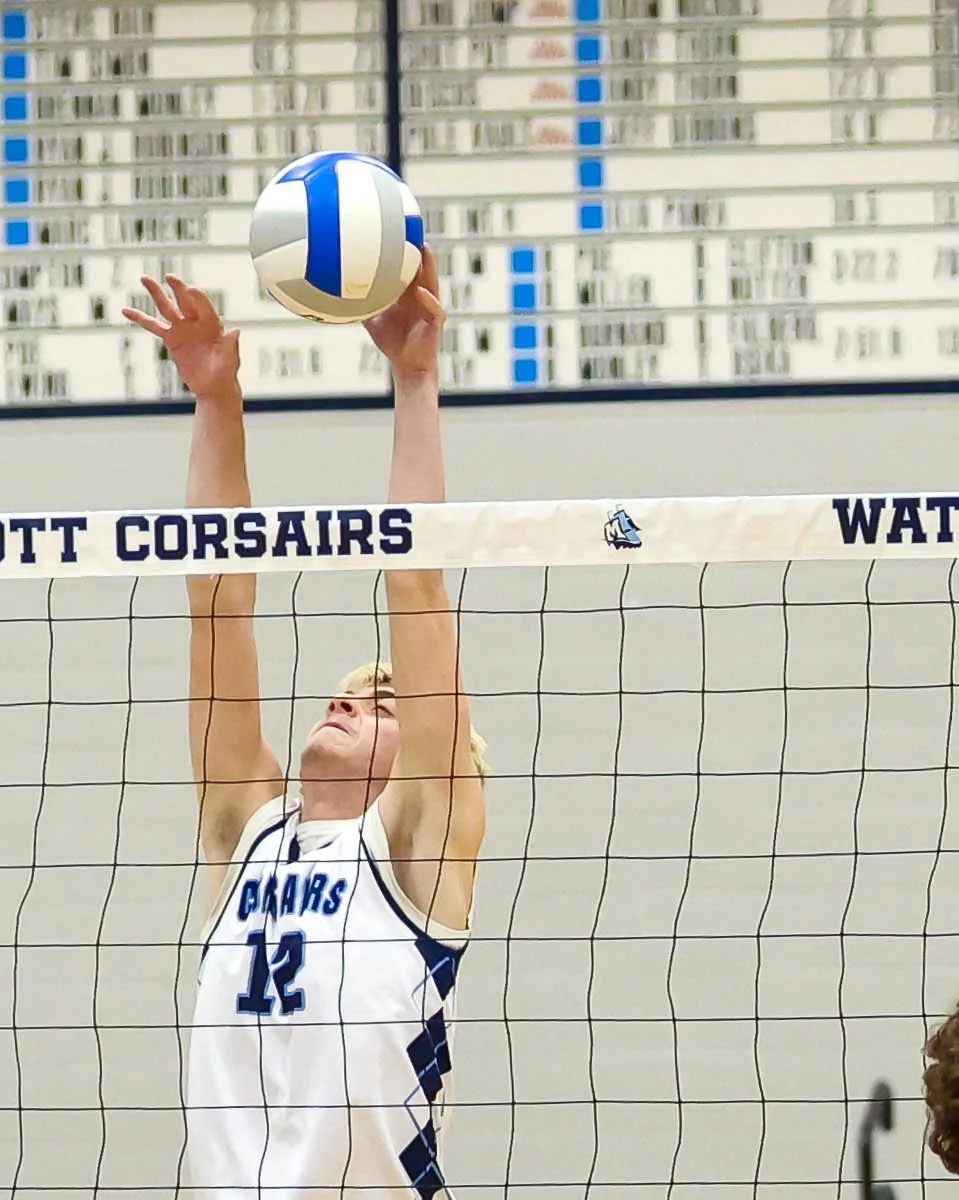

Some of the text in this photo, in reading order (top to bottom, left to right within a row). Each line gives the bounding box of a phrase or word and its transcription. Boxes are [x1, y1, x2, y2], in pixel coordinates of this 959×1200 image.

[115, 507, 414, 562] CORSAIRS
[832, 496, 959, 545] WAT
[236, 928, 306, 1016] 12
